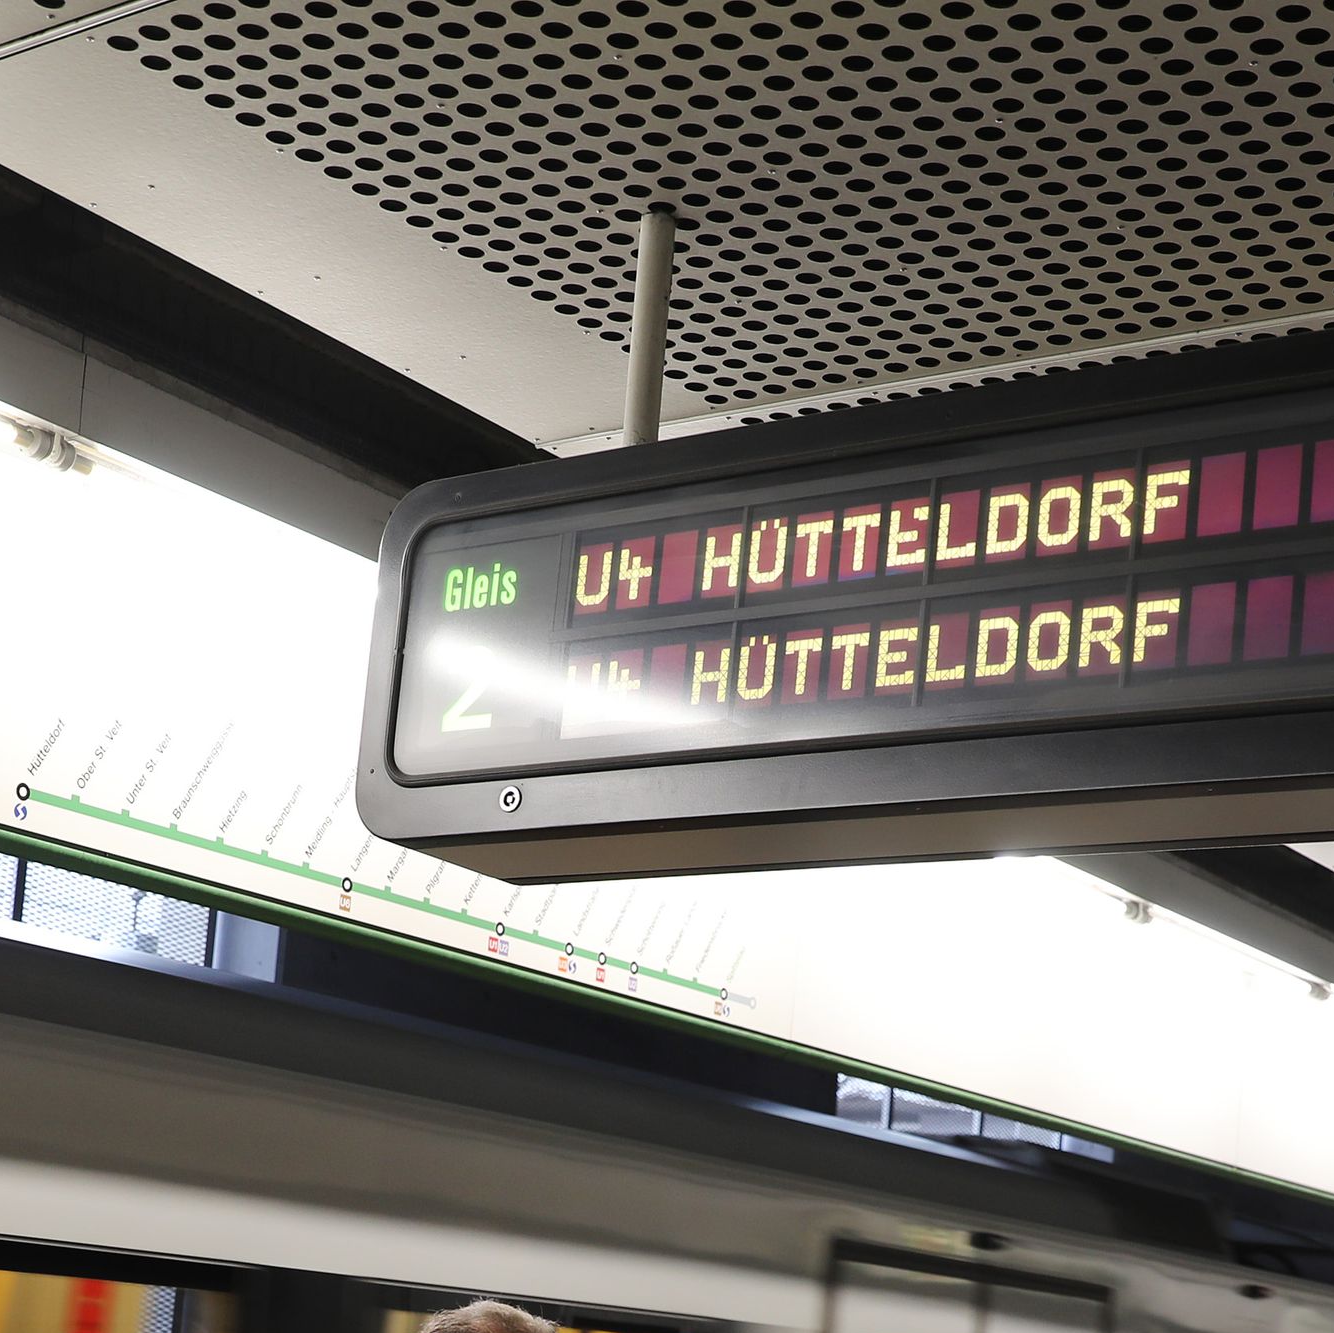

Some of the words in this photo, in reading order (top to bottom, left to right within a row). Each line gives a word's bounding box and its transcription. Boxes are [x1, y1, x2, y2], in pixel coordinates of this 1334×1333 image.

[576, 548, 654, 607] U4
[701, 468, 1191, 592] HÜTTELDORF
[444, 563, 518, 613] Gleis
[690, 597, 1181, 707] HÜTTELDORF
[440, 645, 494, 733] 2
[76, 760, 98, 791] Ober
[125, 773, 148, 806] Unter
[218, 789, 249, 835] Hietzing
[304, 815, 333, 859] Meidling
[350, 834, 374, 873] Langen
